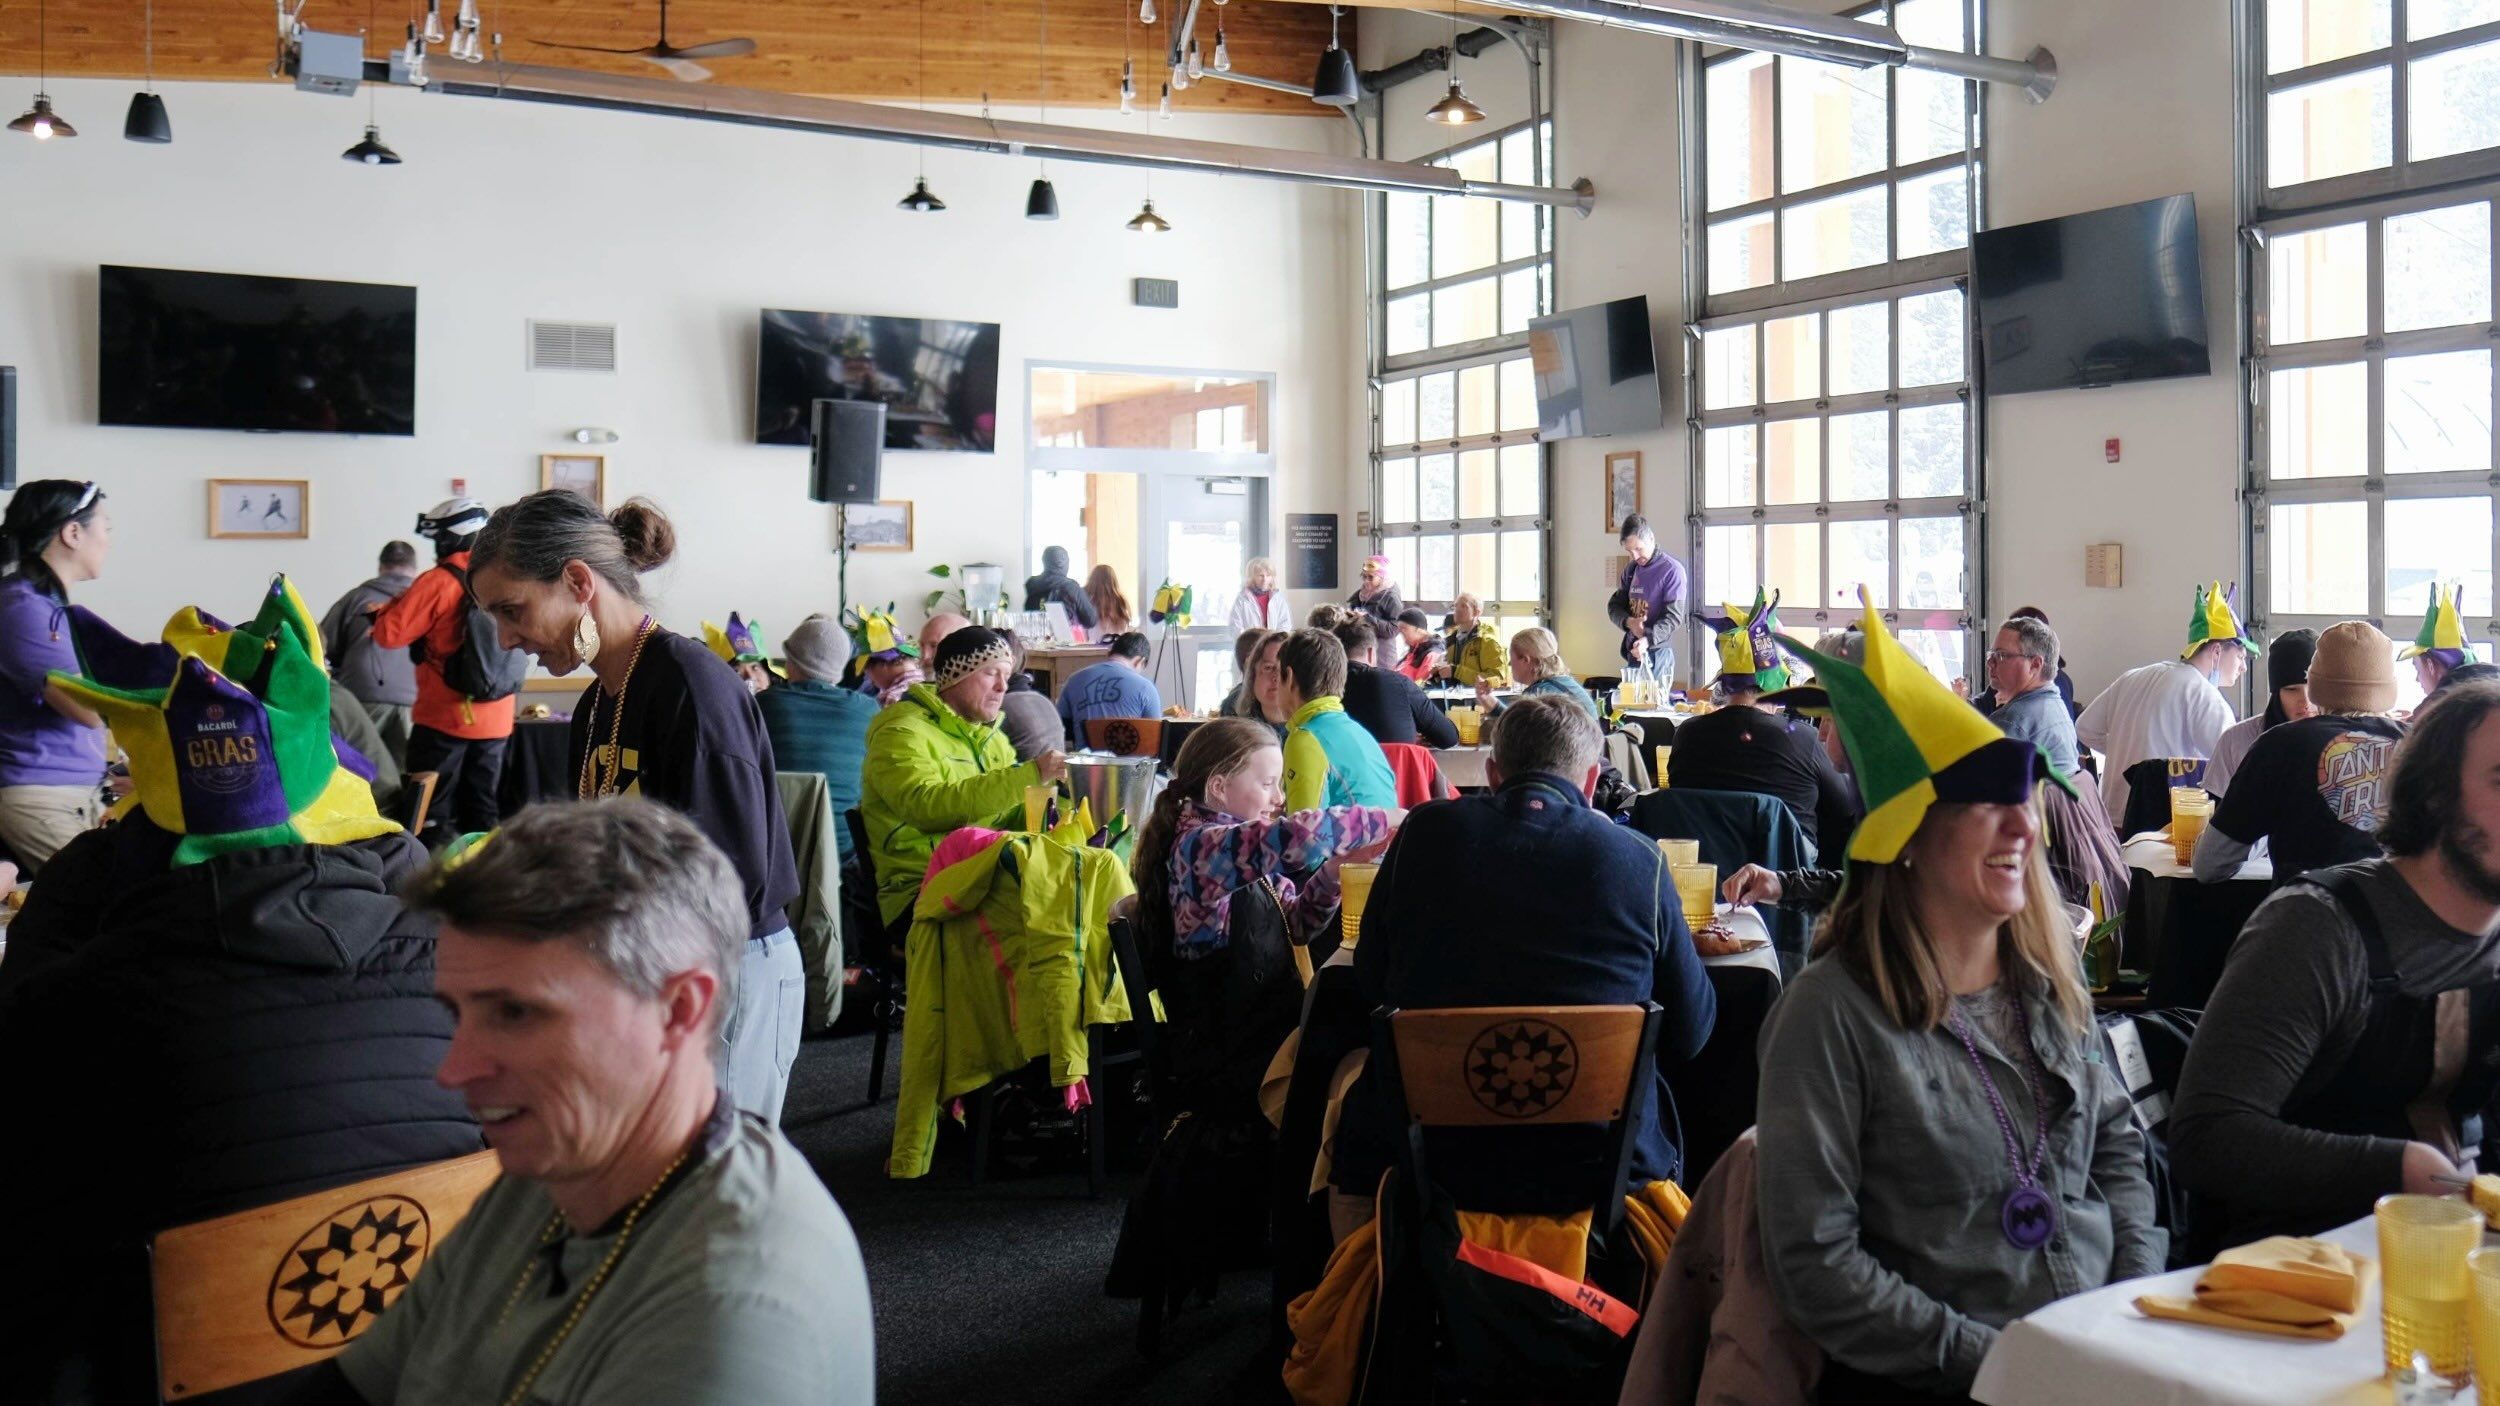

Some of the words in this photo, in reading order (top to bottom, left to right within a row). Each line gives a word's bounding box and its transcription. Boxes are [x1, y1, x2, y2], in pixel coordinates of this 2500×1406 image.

[1144, 280, 1172, 304] EXIT
[187, 736, 257, 768] GRAS
[2317, 742, 2394, 791] SANT
[1575, 1287, 1607, 1313] HH
